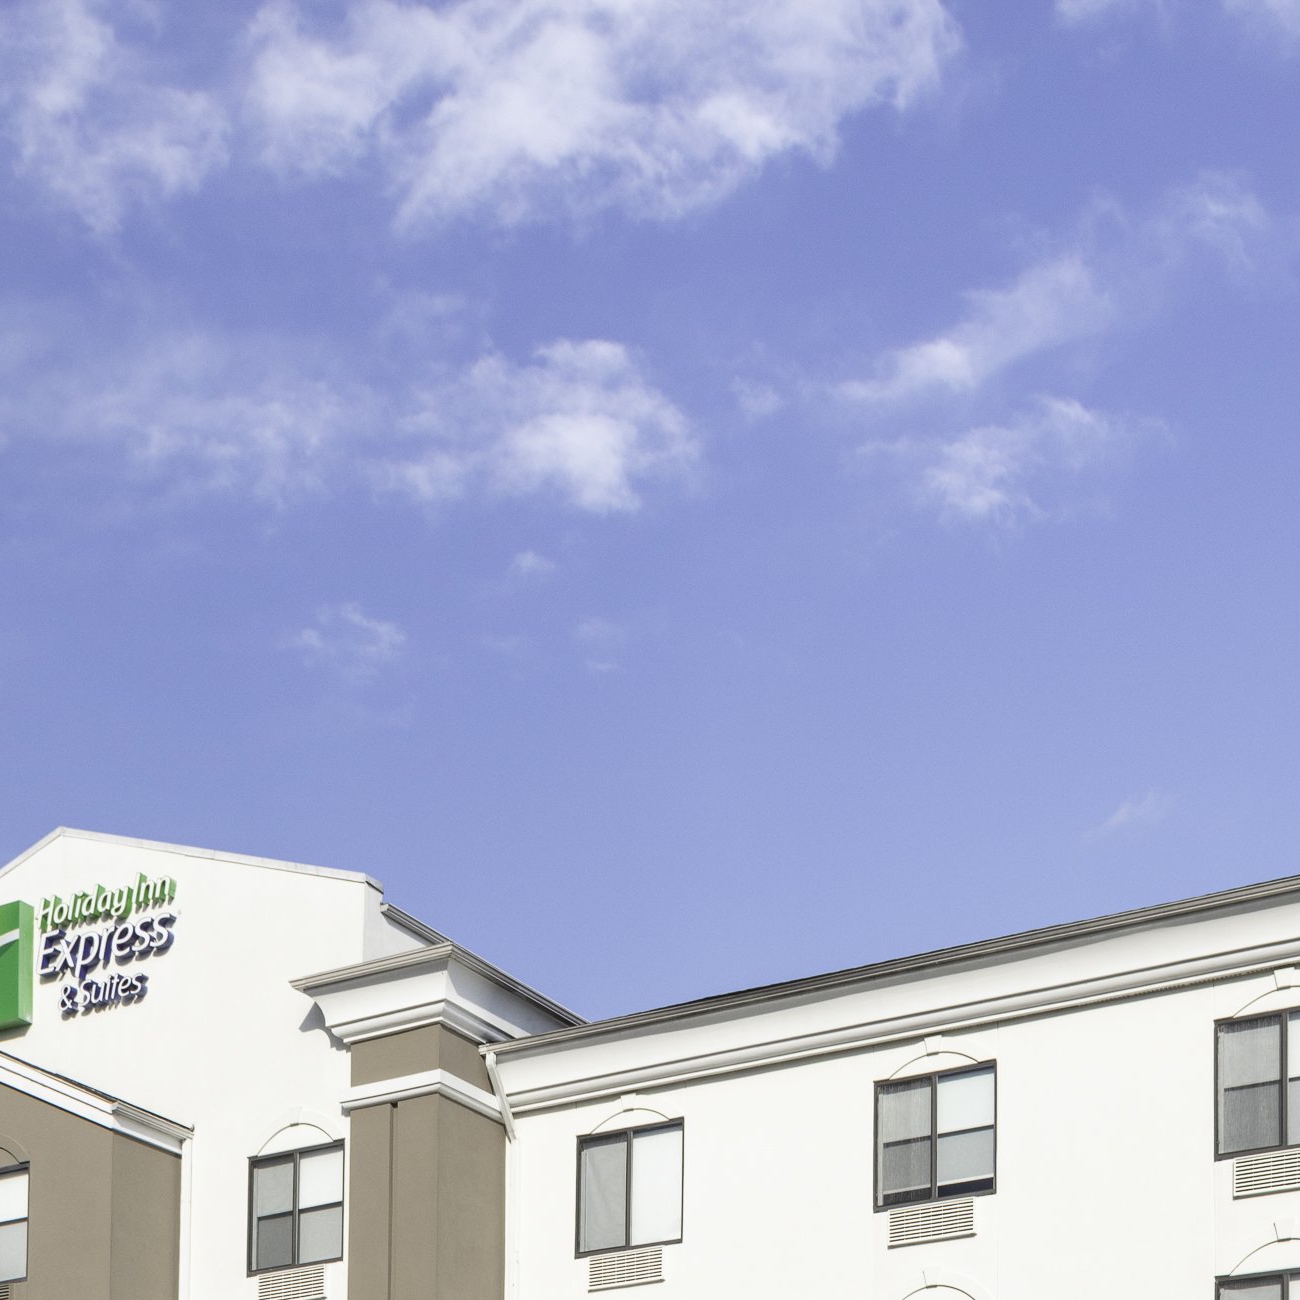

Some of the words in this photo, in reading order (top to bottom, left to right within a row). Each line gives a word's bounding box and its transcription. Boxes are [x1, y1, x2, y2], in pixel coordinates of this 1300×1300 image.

[37, 884, 132, 931] Holiday
[132, 872, 176, 906] Inn
[37, 912, 177, 979] Express
[59, 984, 78, 1012] &
[79, 972, 148, 1007] Suites
